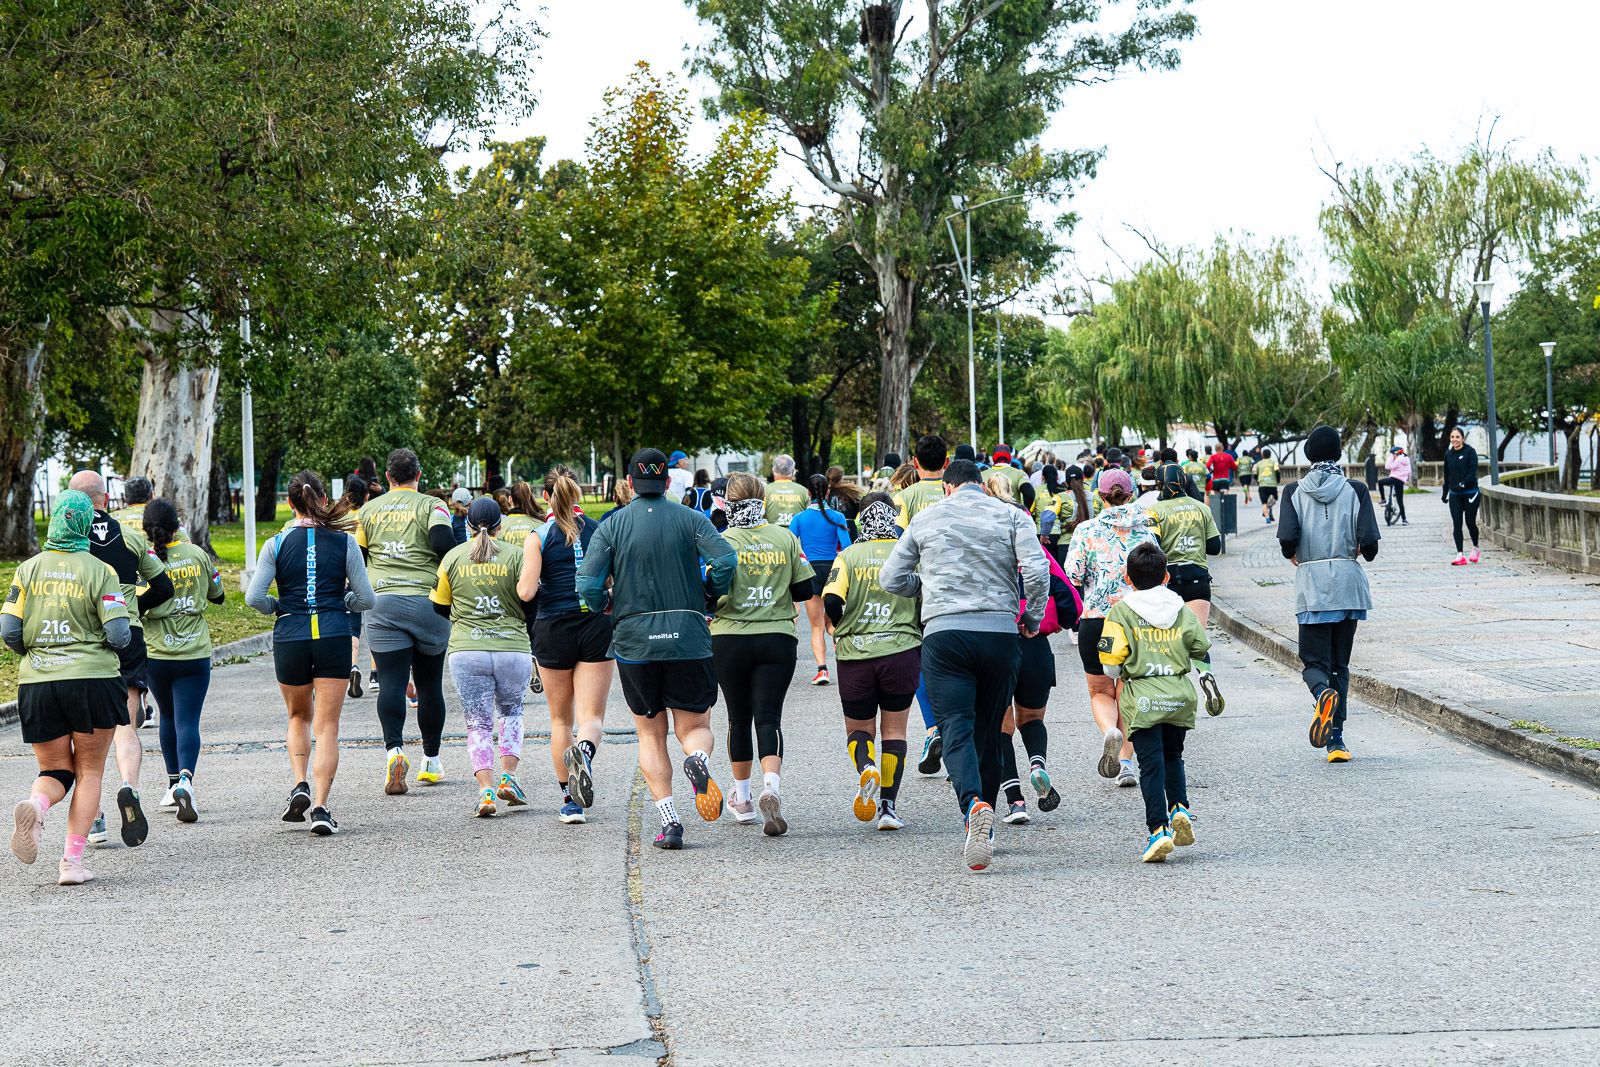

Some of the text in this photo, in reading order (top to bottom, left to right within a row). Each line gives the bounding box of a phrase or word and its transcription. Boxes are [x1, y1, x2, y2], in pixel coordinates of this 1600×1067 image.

[777, 512, 793, 522] 216
[381, 540, 406, 553] 216
[457, 563, 508, 578] VICTORIA
[31, 580, 85, 600] VICTORIA
[747, 585, 773, 600] 216
[174, 595, 195, 609] 216
[473, 595, 500, 610] 216
[863, 602, 891, 617] 216
[40, 619, 71, 635] 216
[648, 632, 673, 640] ansilta
[1144, 662, 1174, 677] 216
